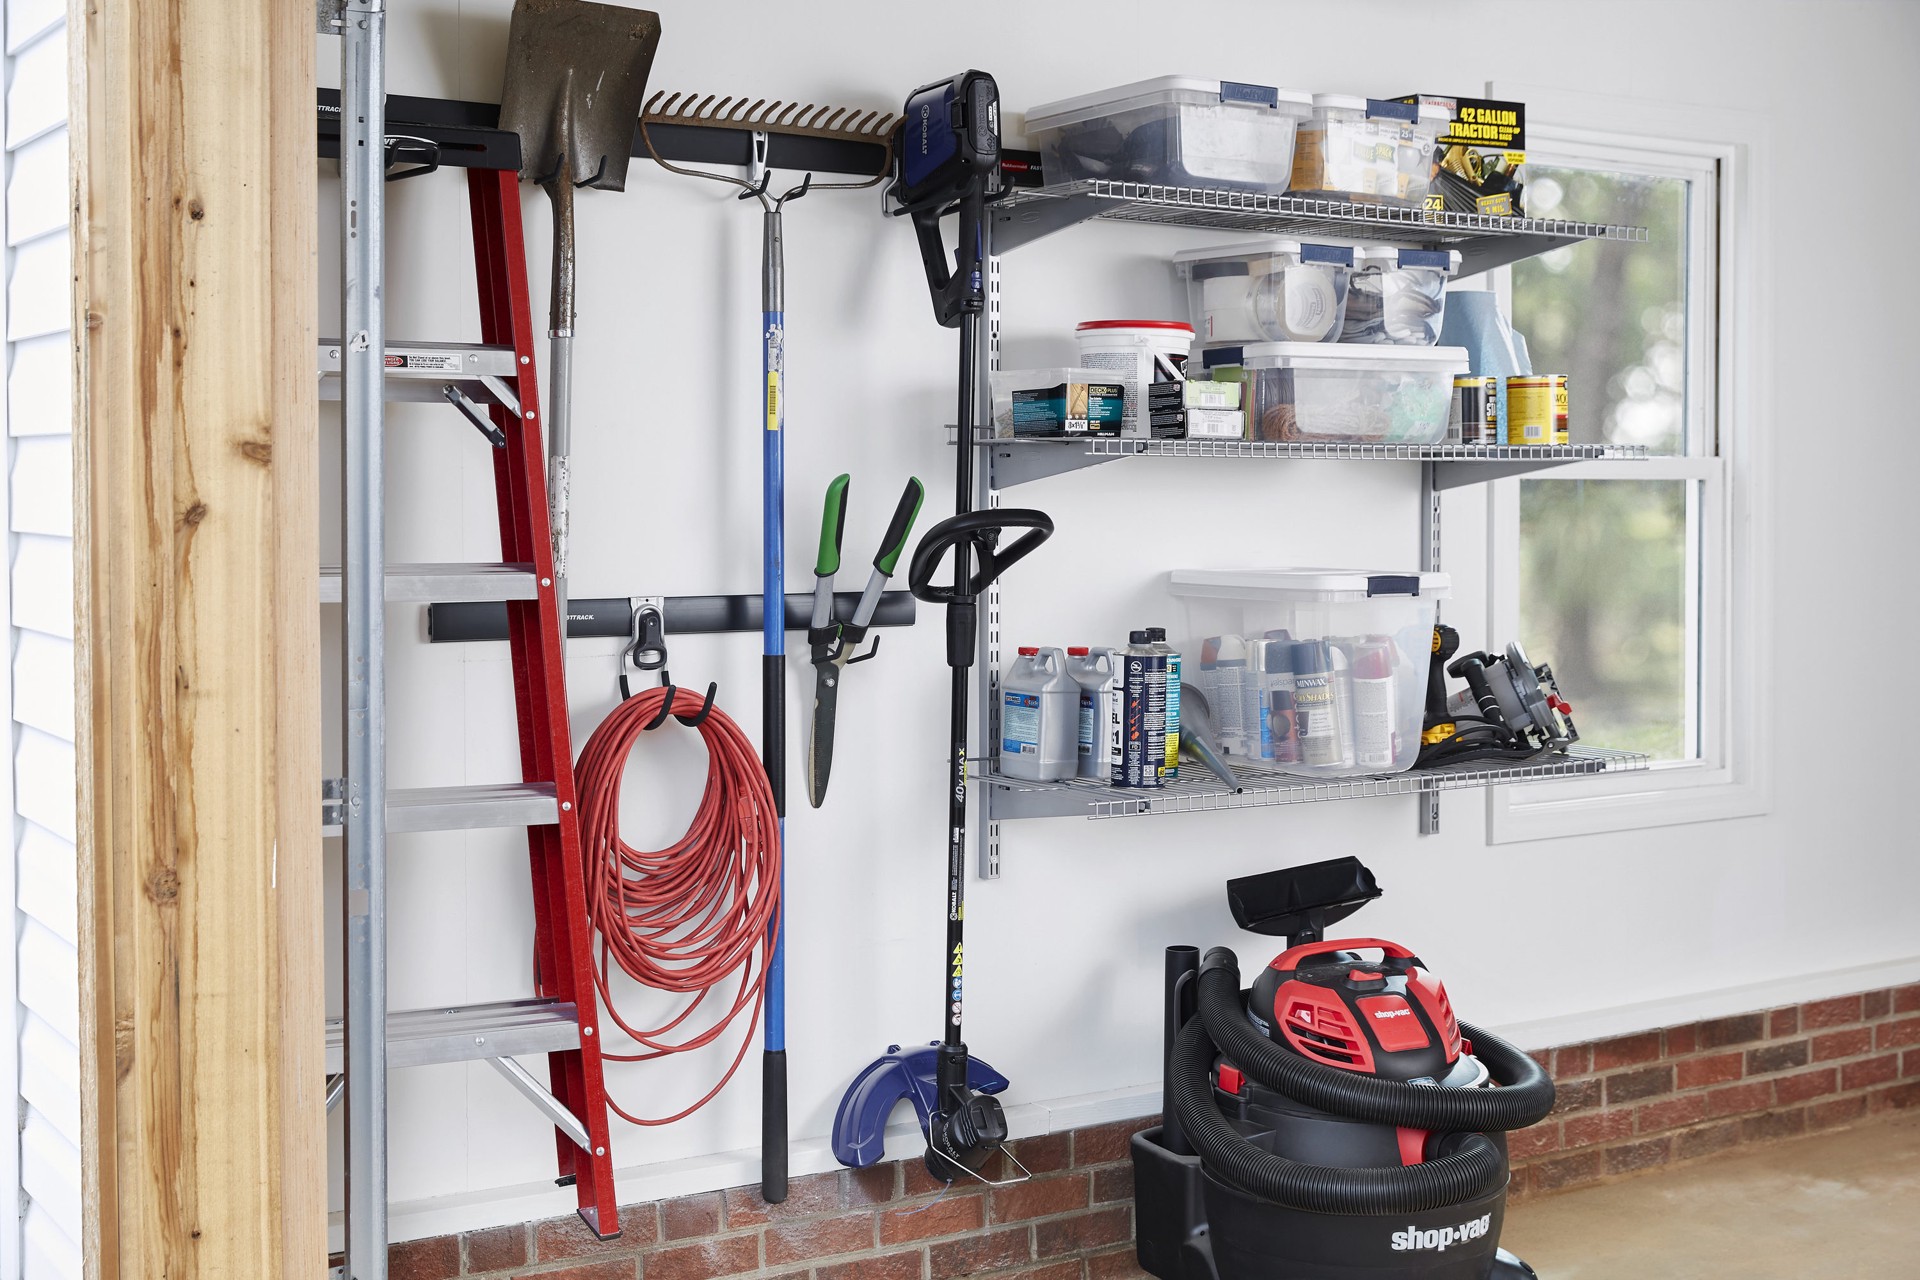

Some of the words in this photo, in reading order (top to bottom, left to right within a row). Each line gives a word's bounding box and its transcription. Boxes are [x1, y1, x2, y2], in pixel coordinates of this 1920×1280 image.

[1460, 107, 1476, 122] 42
[1477, 109, 1517, 126] GALLON
[1449, 122, 1498, 139] TRACTOR
[1001, 162, 1028, 170] Rubbermaid
[1423, 198, 1441, 210] 24
[1296, 678, 1326, 688] MINWAX
[957, 747, 965, 776] MAX
